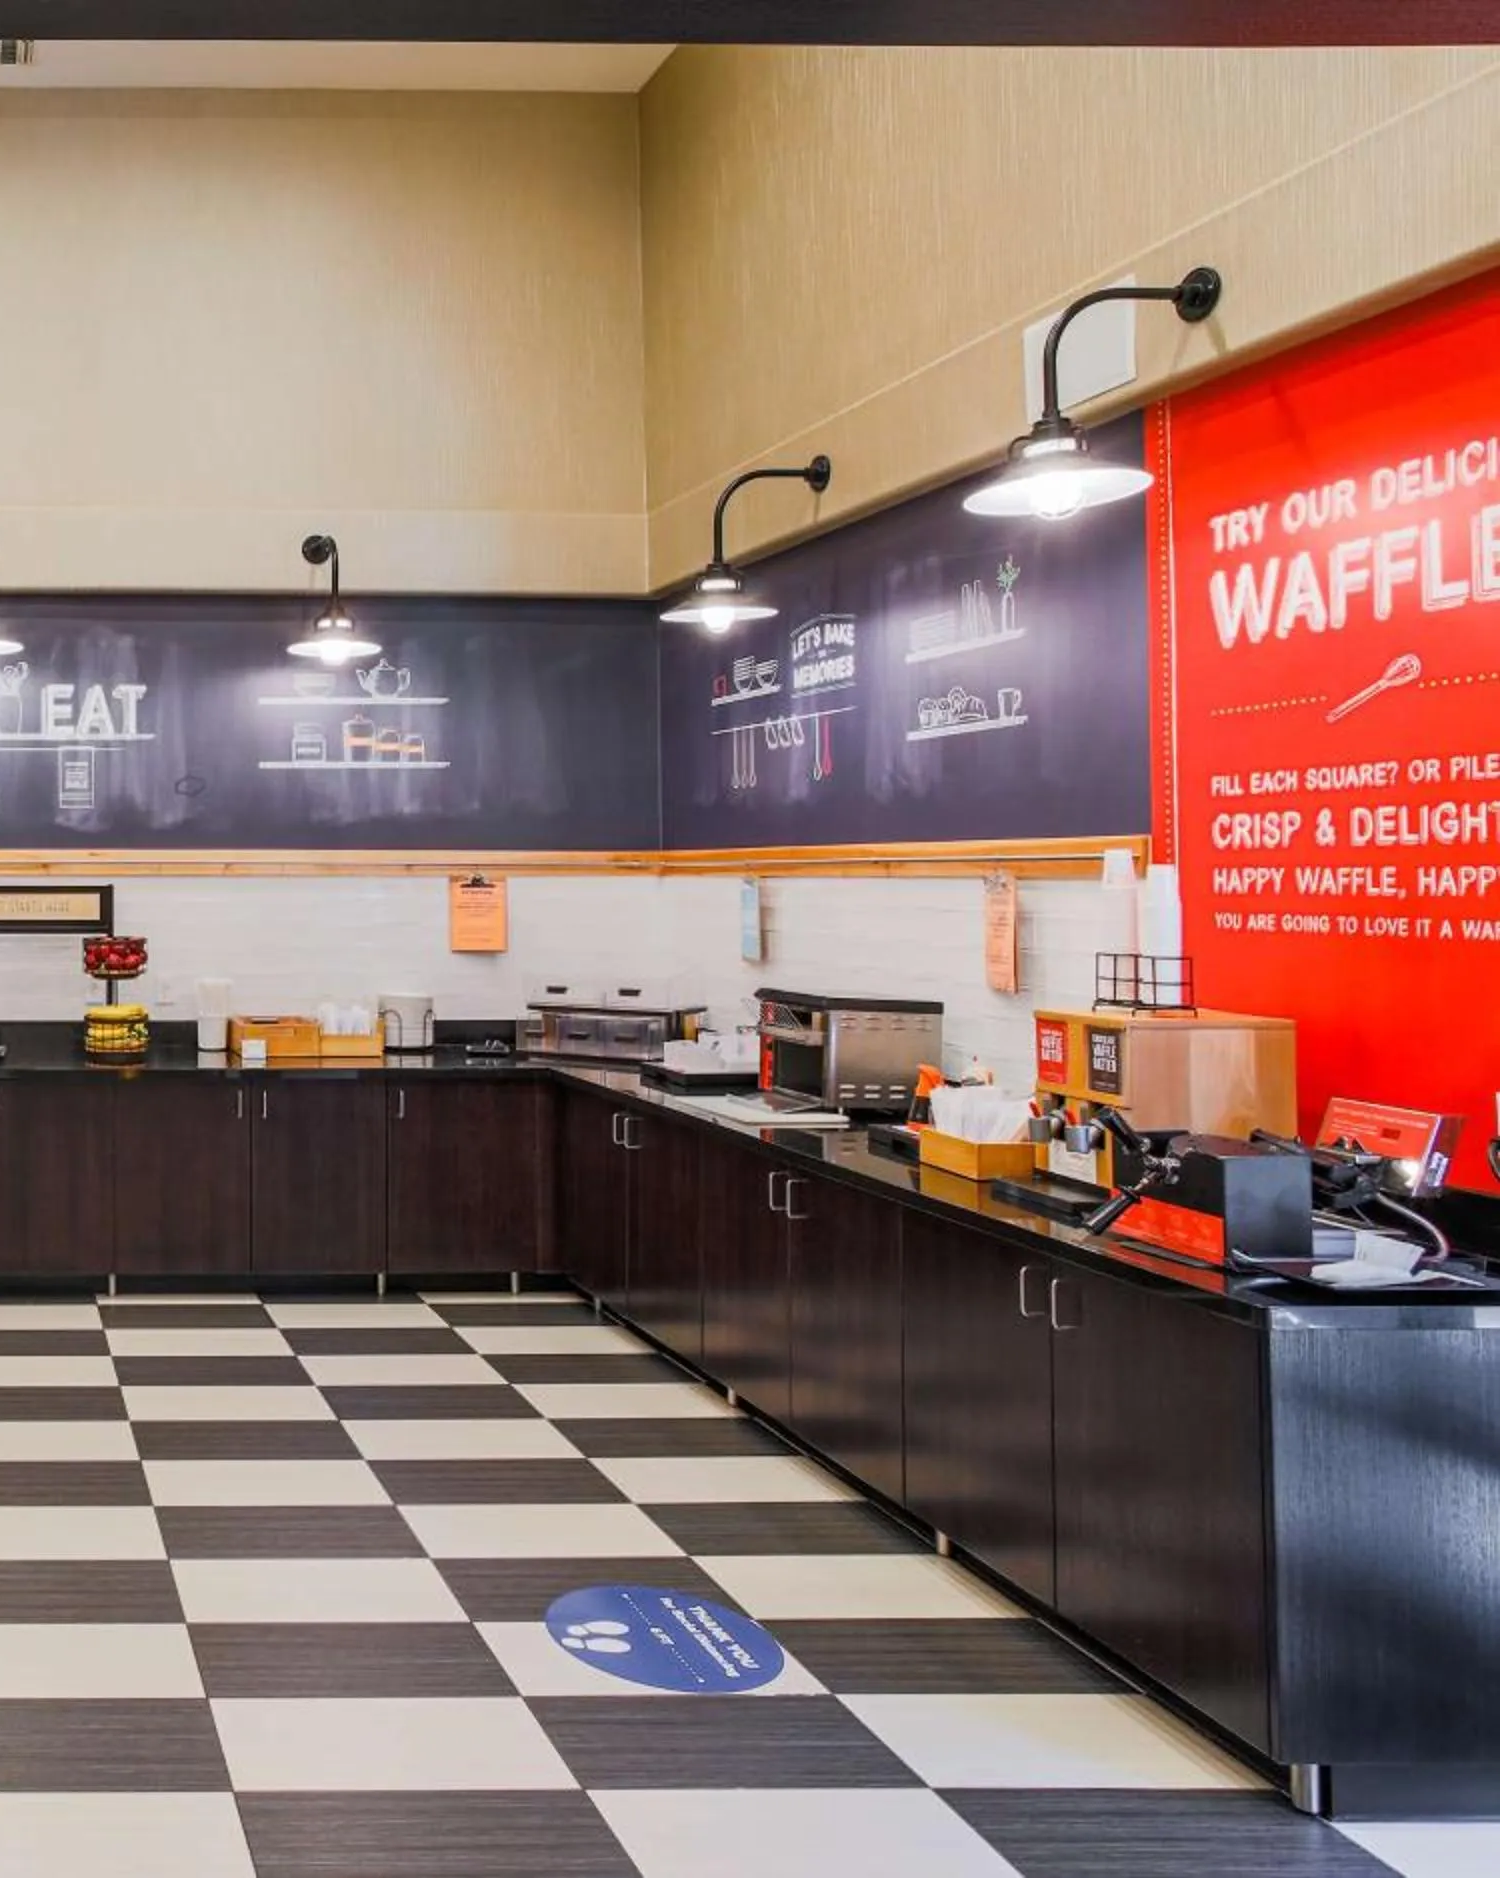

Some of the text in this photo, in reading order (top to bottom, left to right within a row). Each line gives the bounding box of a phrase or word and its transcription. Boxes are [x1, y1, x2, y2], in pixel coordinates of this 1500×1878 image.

[1209, 436, 1499, 552] TRY OUR DELICI
[1209, 504, 1500, 650] WAFFLE
[41, 682, 147, 738] EAT
[1211, 775, 1244, 796] FILL
[1250, 771, 1298, 794] EACH
[1305, 761, 1399, 791] SQUARE?
[1407, 759, 1441, 784] OR
[1212, 809, 1302, 849] CRISP
[1315, 807, 1337, 847] &
[1212, 865, 1500, 900] HAPPY WAFFLE, HAPP
[1214, 912, 1242, 929] YOU
[1247, 913, 1276, 932] ARE
[1282, 914, 1330, 933] GOING
[1336, 916, 1357, 936] TO
[1365, 917, 1408, 937] LOVE
[1415, 919, 1432, 938] IT
[1439, 919, 1453, 939] A
